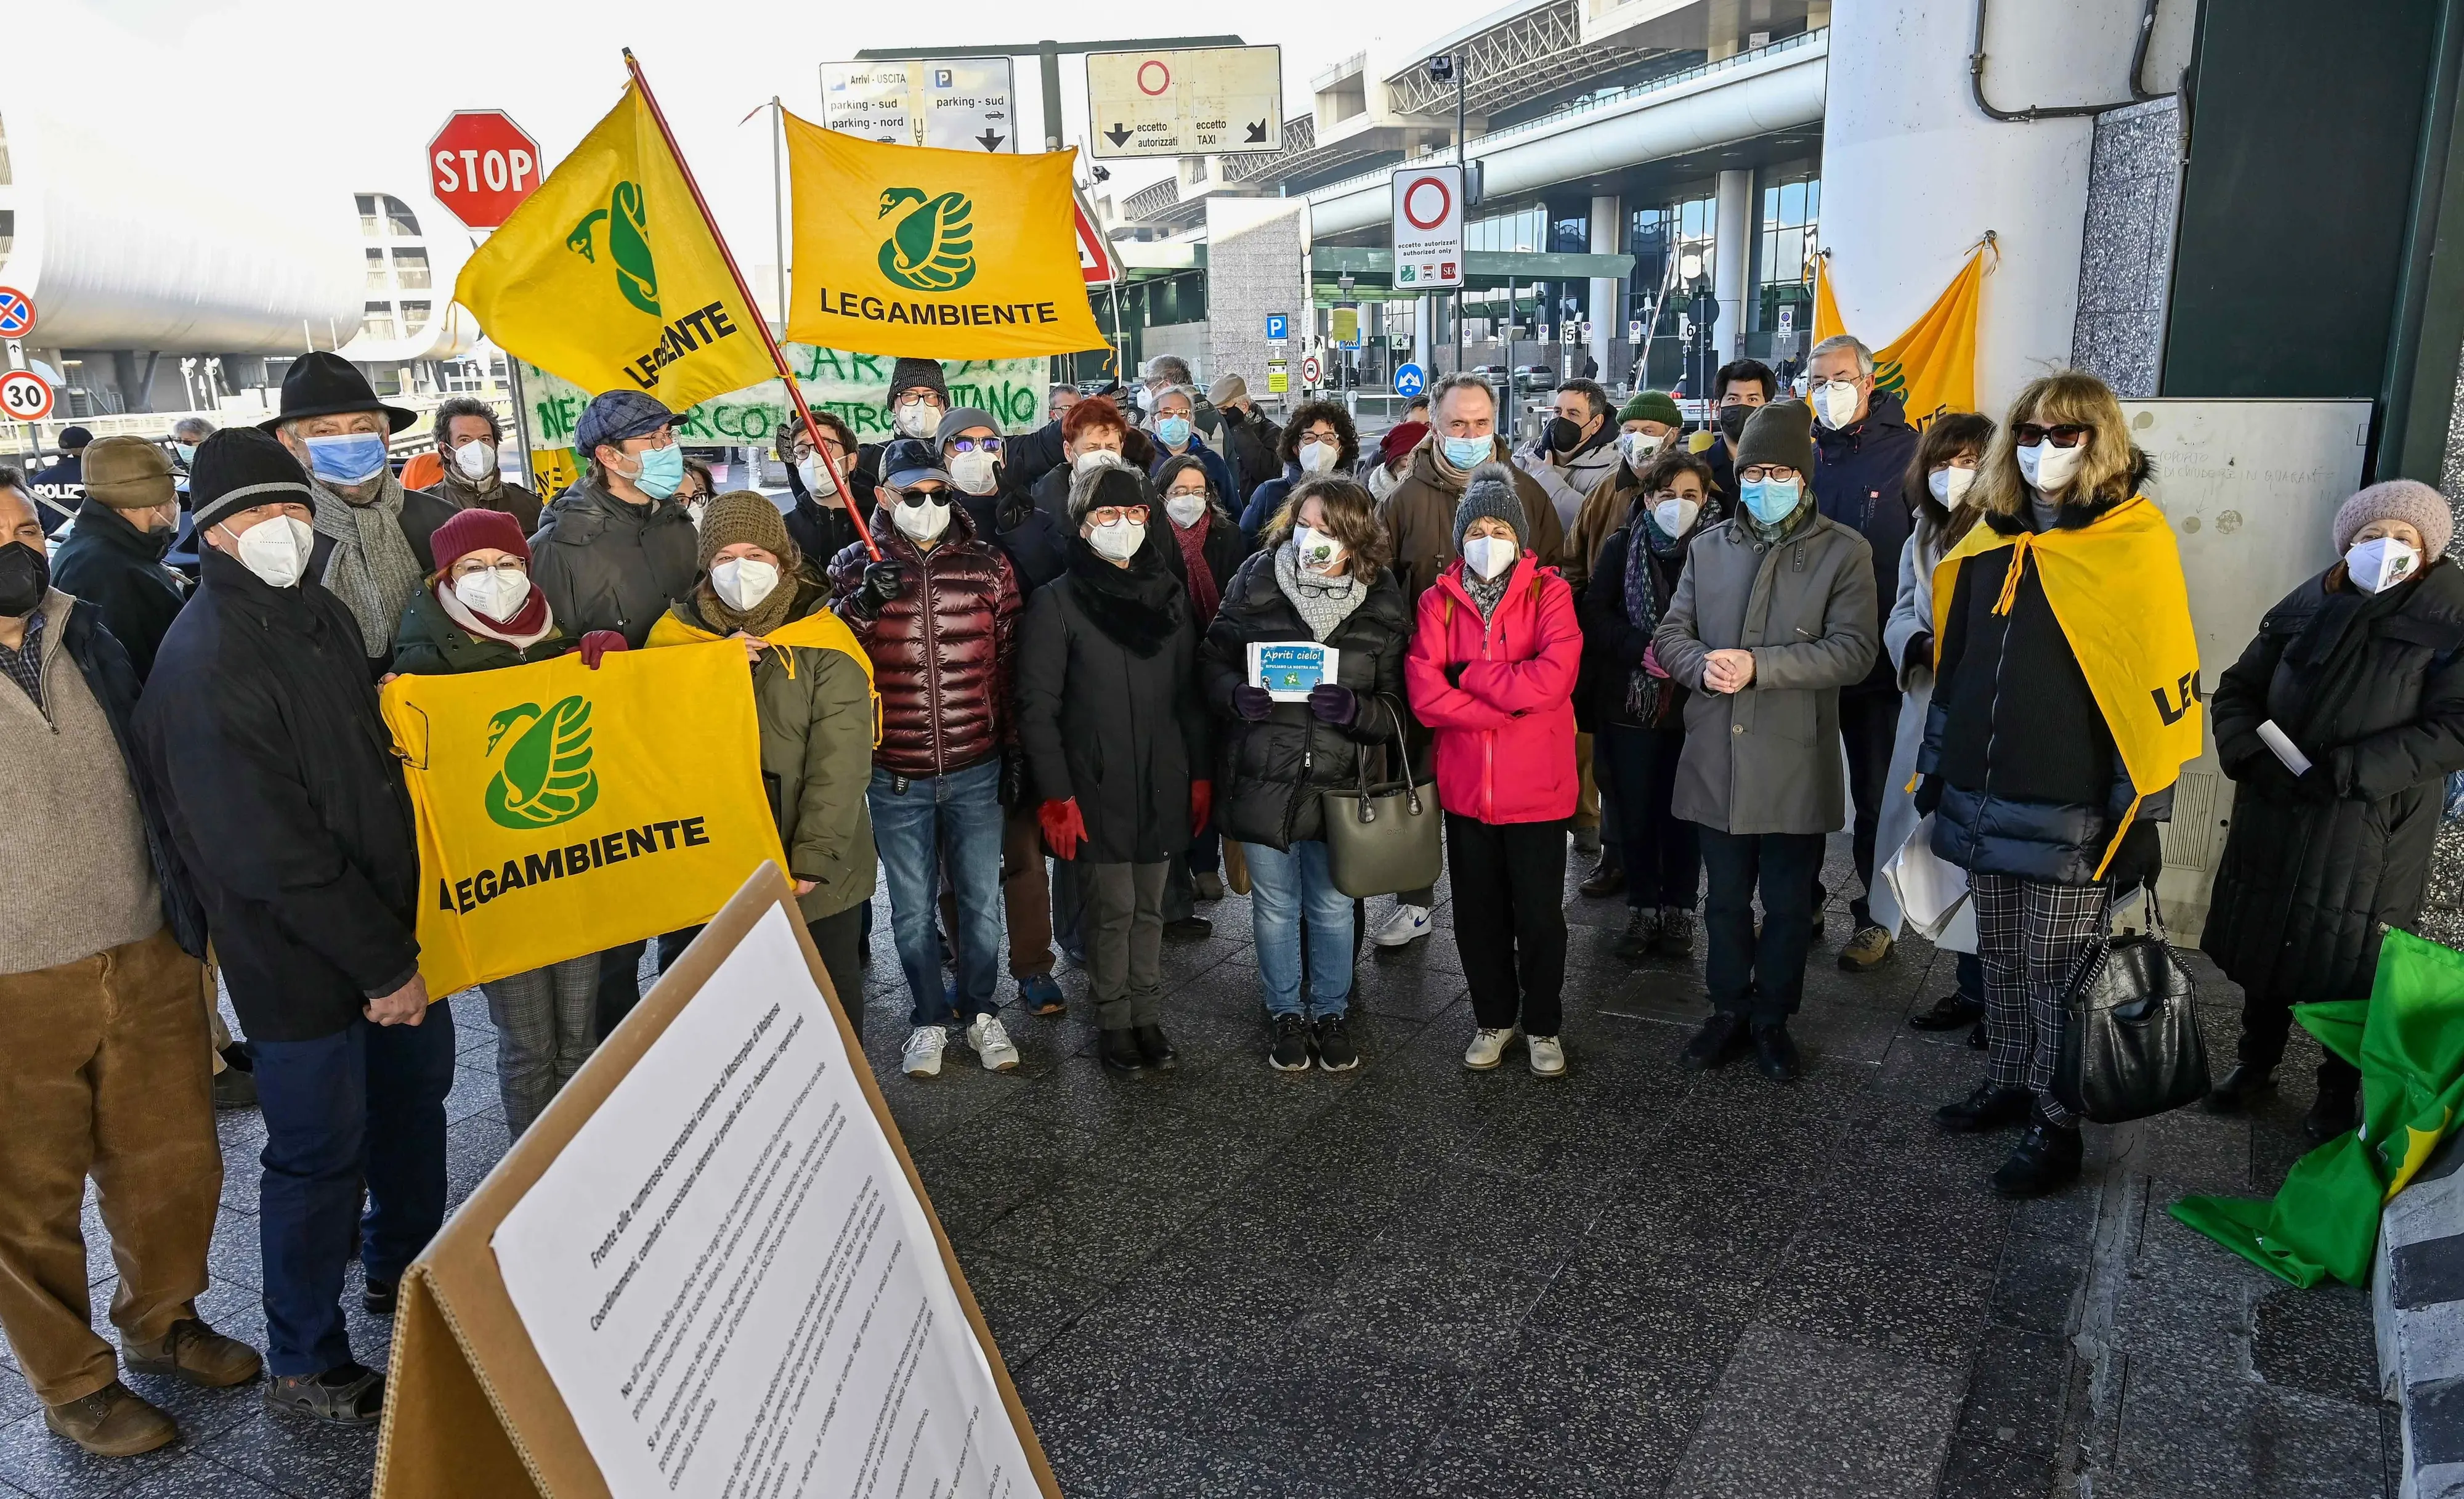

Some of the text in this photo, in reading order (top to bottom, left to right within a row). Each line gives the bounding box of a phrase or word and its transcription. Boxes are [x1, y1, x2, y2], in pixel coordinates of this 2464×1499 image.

[851, 75, 870, 84] Arrivi
[877, 74, 906, 84] USCITA
[830, 100, 869, 112] parking
[878, 99, 898, 109] sud
[936, 97, 975, 109] parking
[985, 95, 1004, 106] sud
[832, 118, 870, 130] parking
[880, 116, 904, 127] nord
[1137, 122, 1167, 132] eccetto
[1196, 119, 1226, 129] eccetto
[1138, 136, 1178, 148] autorizzati
[1197, 135, 1217, 145] TAXI
[434, 148, 533, 193] STOP
[1424, 239, 1457, 247] autorizzati
[1443, 267, 1456, 275] SEA
[820, 286, 1058, 327] LEGAMBIENTE
[1270, 319, 1283, 336] P
[1687, 323, 1694, 337] 6
[1566, 329, 1574, 341] 5
[1396, 338, 1403, 347] 4
[7, 385, 41, 407] 30
[1265, 650, 1321, 661] Apriti cielo!
[439, 816, 710, 916] LEGAMBIENTE
